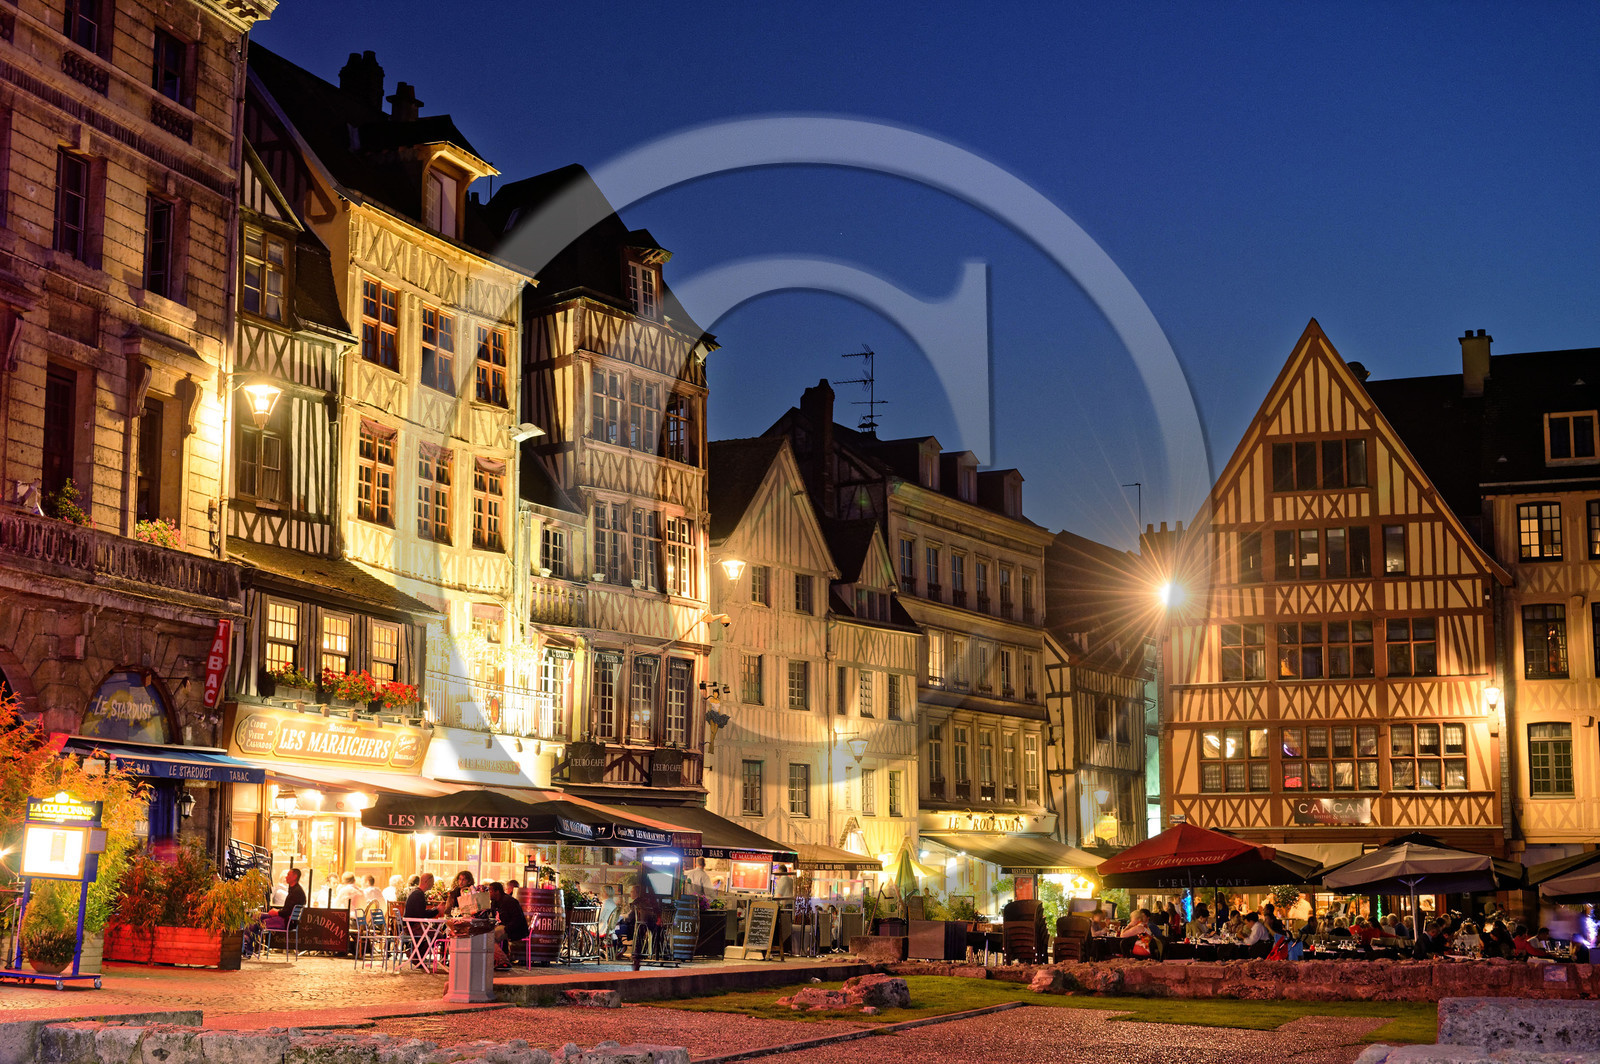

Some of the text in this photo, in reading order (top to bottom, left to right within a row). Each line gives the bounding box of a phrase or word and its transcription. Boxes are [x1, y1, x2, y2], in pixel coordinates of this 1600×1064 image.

[204, 622, 224, 704] TABAC
[111, 700, 153, 720] STARDUST
[279, 728, 306, 750] LES
[307, 731, 391, 759] MARAICHERS
[571, 758, 591, 767] L'EURO
[653, 763, 670, 772] L'EURO
[136, 763, 249, 782] BAR LE STARDUST TABAC
[29, 803, 42, 813] LA
[42, 803, 96, 816] COURONNE
[1298, 803, 1365, 814] CANCAN
[388, 814, 529, 829] LES MARAICHERS
[948, 817, 1024, 832] LE ROUENNAIS
[710, 849, 724, 858] BARS
[1146, 853, 1227, 867] Maupassant
[680, 921, 693, 933] LES
